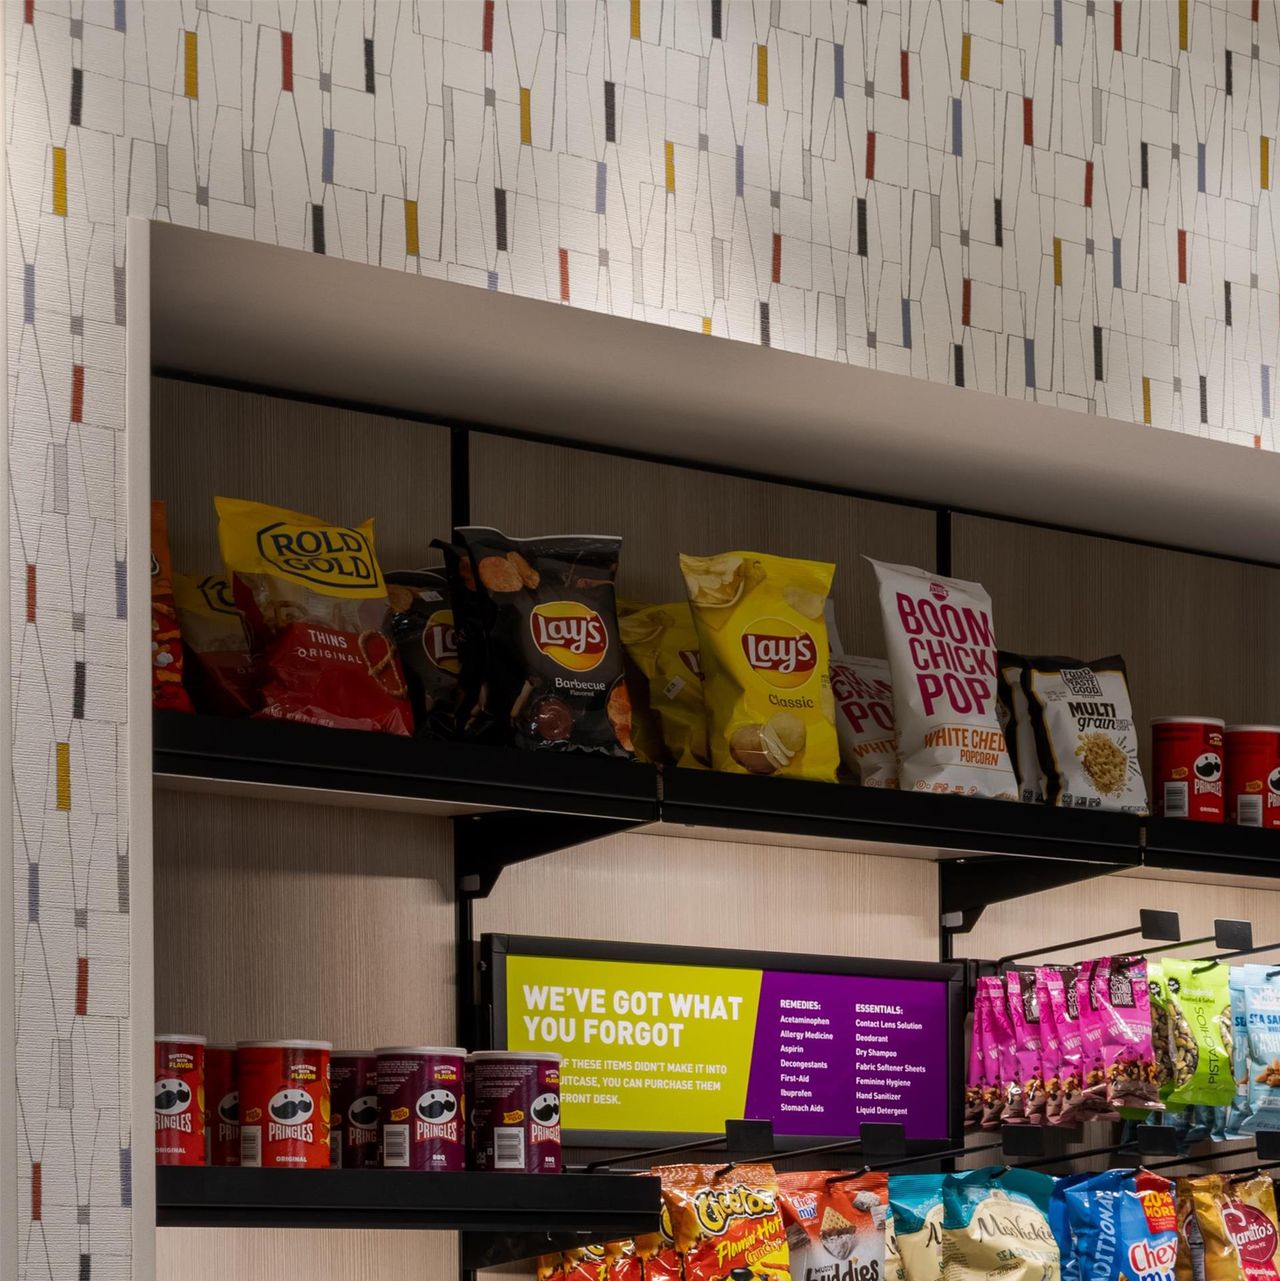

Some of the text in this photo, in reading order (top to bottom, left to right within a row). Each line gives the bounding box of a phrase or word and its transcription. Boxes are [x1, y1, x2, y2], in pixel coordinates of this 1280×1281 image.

[270, 529, 363, 557] ROLD
[283, 556, 370, 579] GOLD
[539, 613, 601, 654] Lay's
[308, 630, 347, 649] THINS
[298, 648, 363, 665] ORIGINAL
[747, 636, 810, 673] Lay's
[555, 678, 606, 691] Barbecue
[768, 694, 814, 709] Classic
[1067, 702, 1116, 719] MULTI
[1078, 716, 1116, 732] grain
[1194, 779, 1222, 797] PRINGLES
[523, 984, 742, 1021] WE'VE GOT WHAT
[780, 999, 821, 1010] REMEDIES:
[856, 1004, 903, 1015] ESSENTIALS:
[780, 1015, 830, 1026] Acetaminophen
[856, 1019, 922, 1030] Contact Lens Solution
[523, 1016, 684, 1047] YOU FORGOT
[780, 1030, 833, 1040] Allergy Medicine
[856, 1033, 888, 1042] Deodorant
[780, 1044, 803, 1054] Aspirin
[856, 1048, 897, 1058] Dry Shampoo
[572, 1059, 727, 1074] THESE ITEMS DIDN'T MAKE IT INTO
[780, 1059, 828, 1069] Decongestants
[856, 1062, 926, 1073] Fabric Softener Sheets
[603, 1077, 720, 1091] YOU CAN PURCHASE THEM
[780, 1074, 809, 1083] First-Aid
[856, 1077, 911, 1087] Feminine Hygiene
[560, 1093, 621, 1104] FRONT DESK.
[780, 1088, 812, 1098] Ibuprofen
[856, 1091, 901, 1101] Hand Sanitizer
[780, 1103, 824, 1112] Stomach Aids
[856, 1106, 907, 1116] Liquid Detergent
[268, 1122, 313, 1143] PRINGLES
